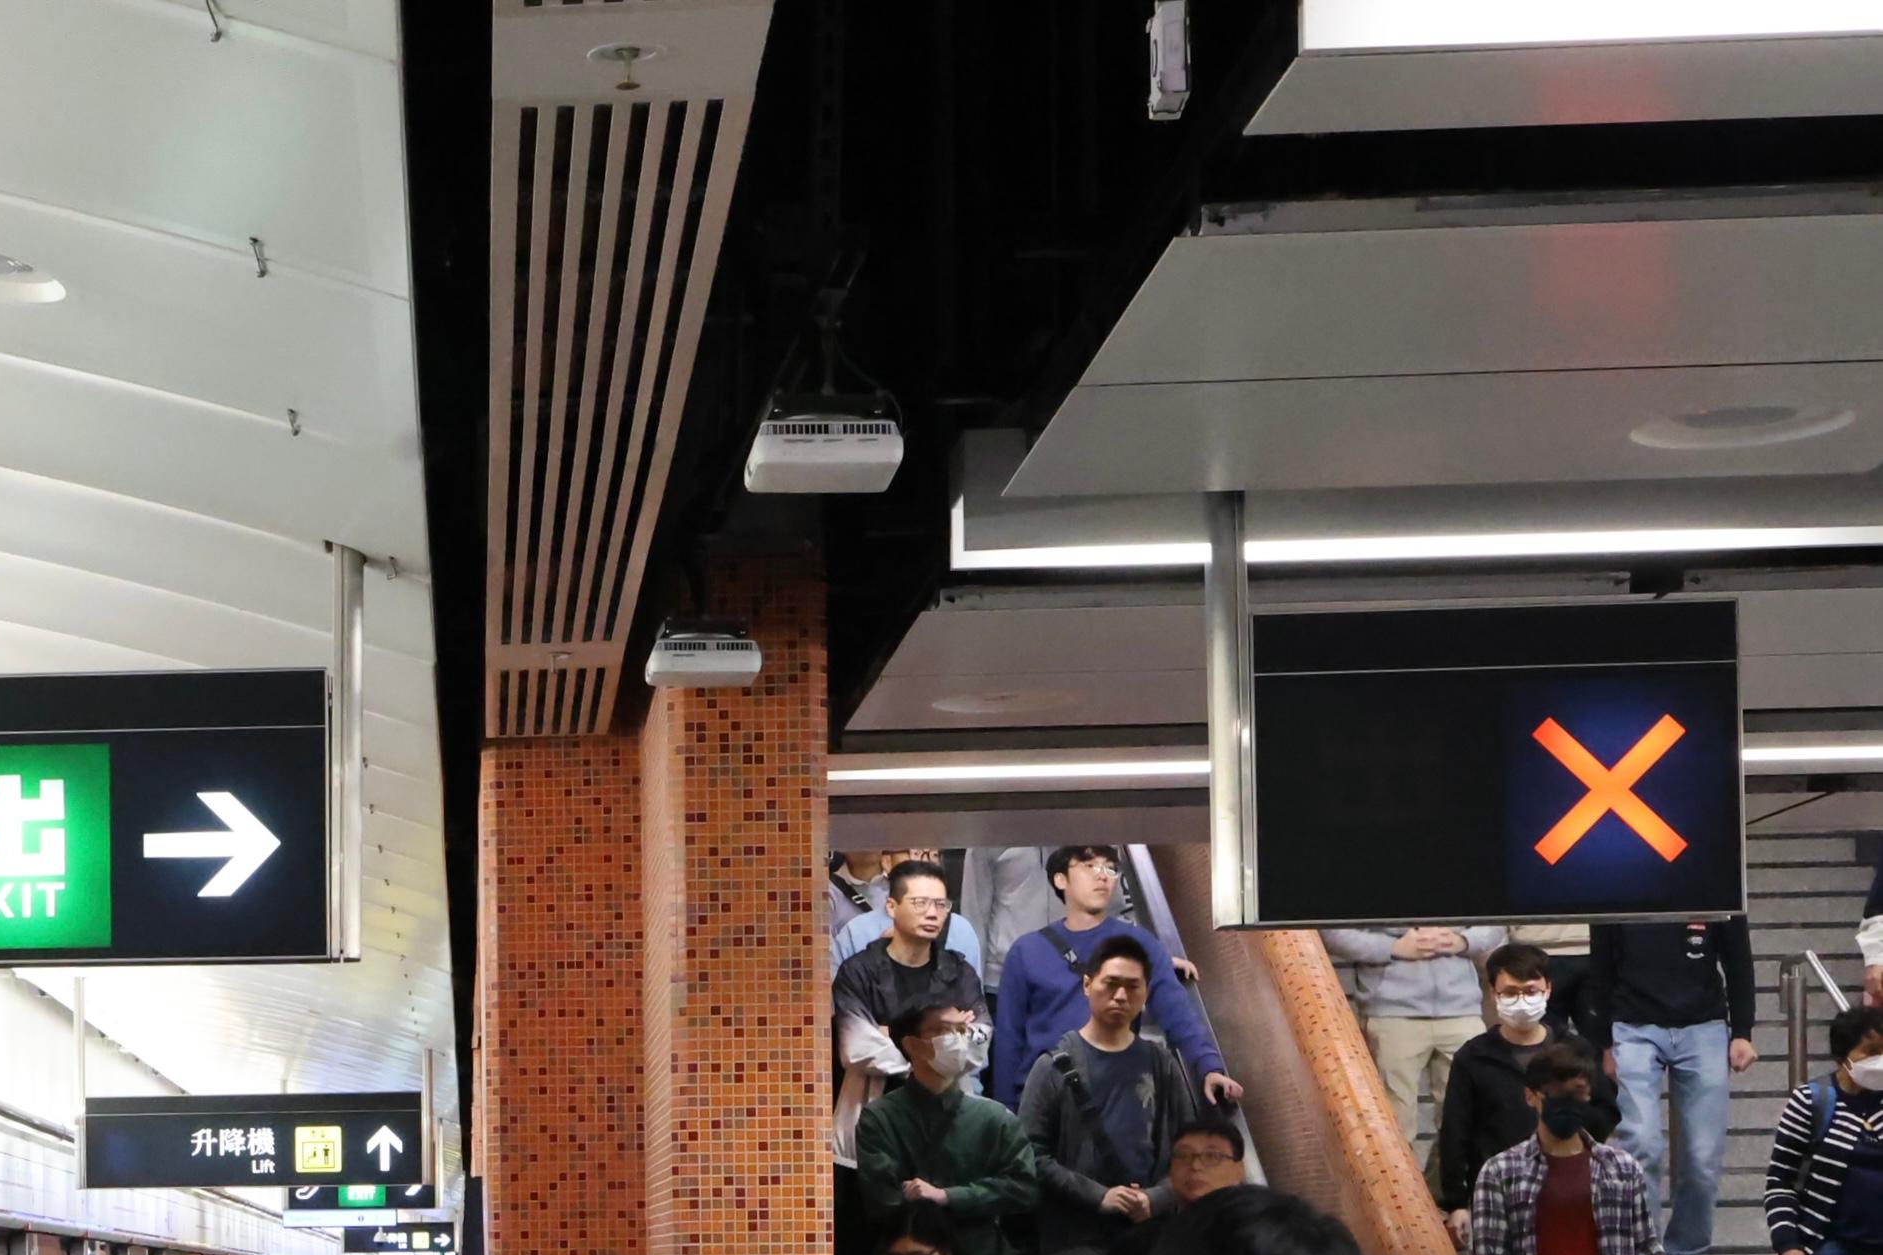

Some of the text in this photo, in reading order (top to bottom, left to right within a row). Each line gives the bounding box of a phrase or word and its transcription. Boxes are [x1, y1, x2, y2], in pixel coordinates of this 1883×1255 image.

[190, 1127, 276, 1157] 升降機
[251, 1159, 276, 1174] Lift
